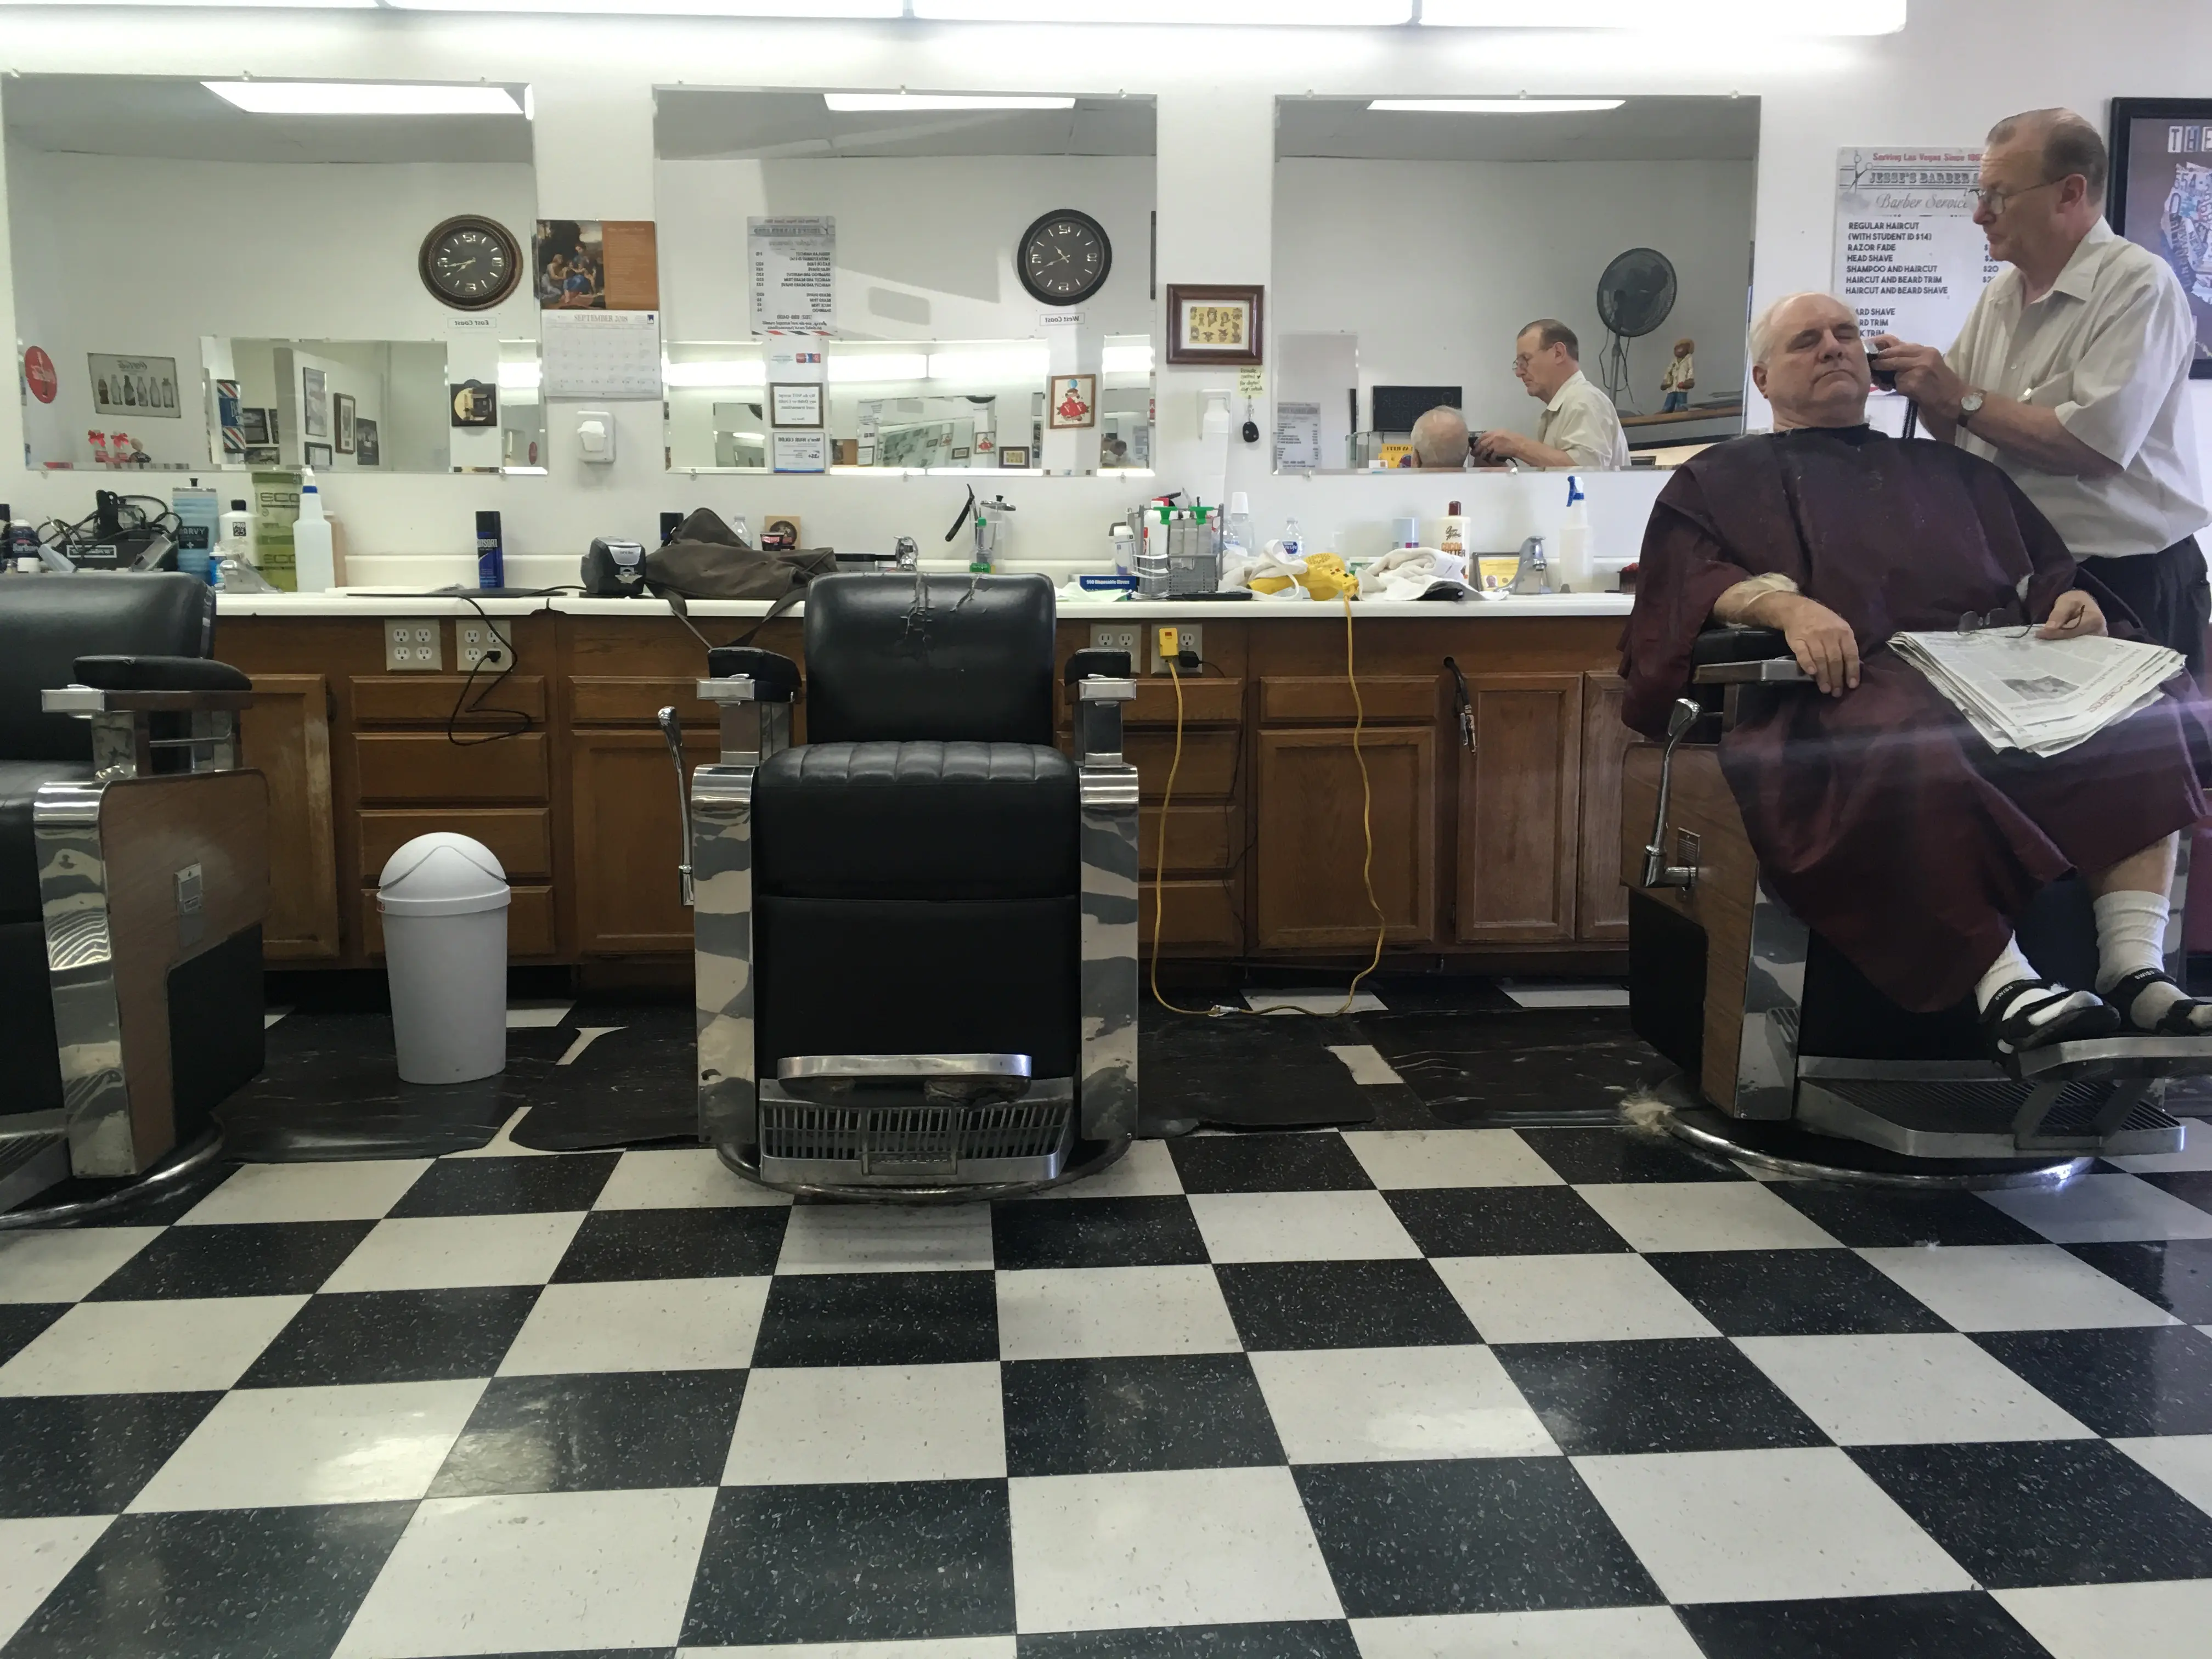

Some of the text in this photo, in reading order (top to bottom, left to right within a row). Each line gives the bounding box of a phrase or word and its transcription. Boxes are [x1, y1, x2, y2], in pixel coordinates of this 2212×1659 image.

[1873, 153, 1901, 162] Serving
[1920, 154, 1941, 162] Vegas
[1870, 172, 1917, 184] JESSE'S
[1920, 172, 1969, 184] BARBER
[1876, 193, 1921, 208] Barber
[261, 492, 300, 502] ECO
[2134, 970, 2155, 980] SWISS
[1995, 985, 2013, 1001] SWISS
